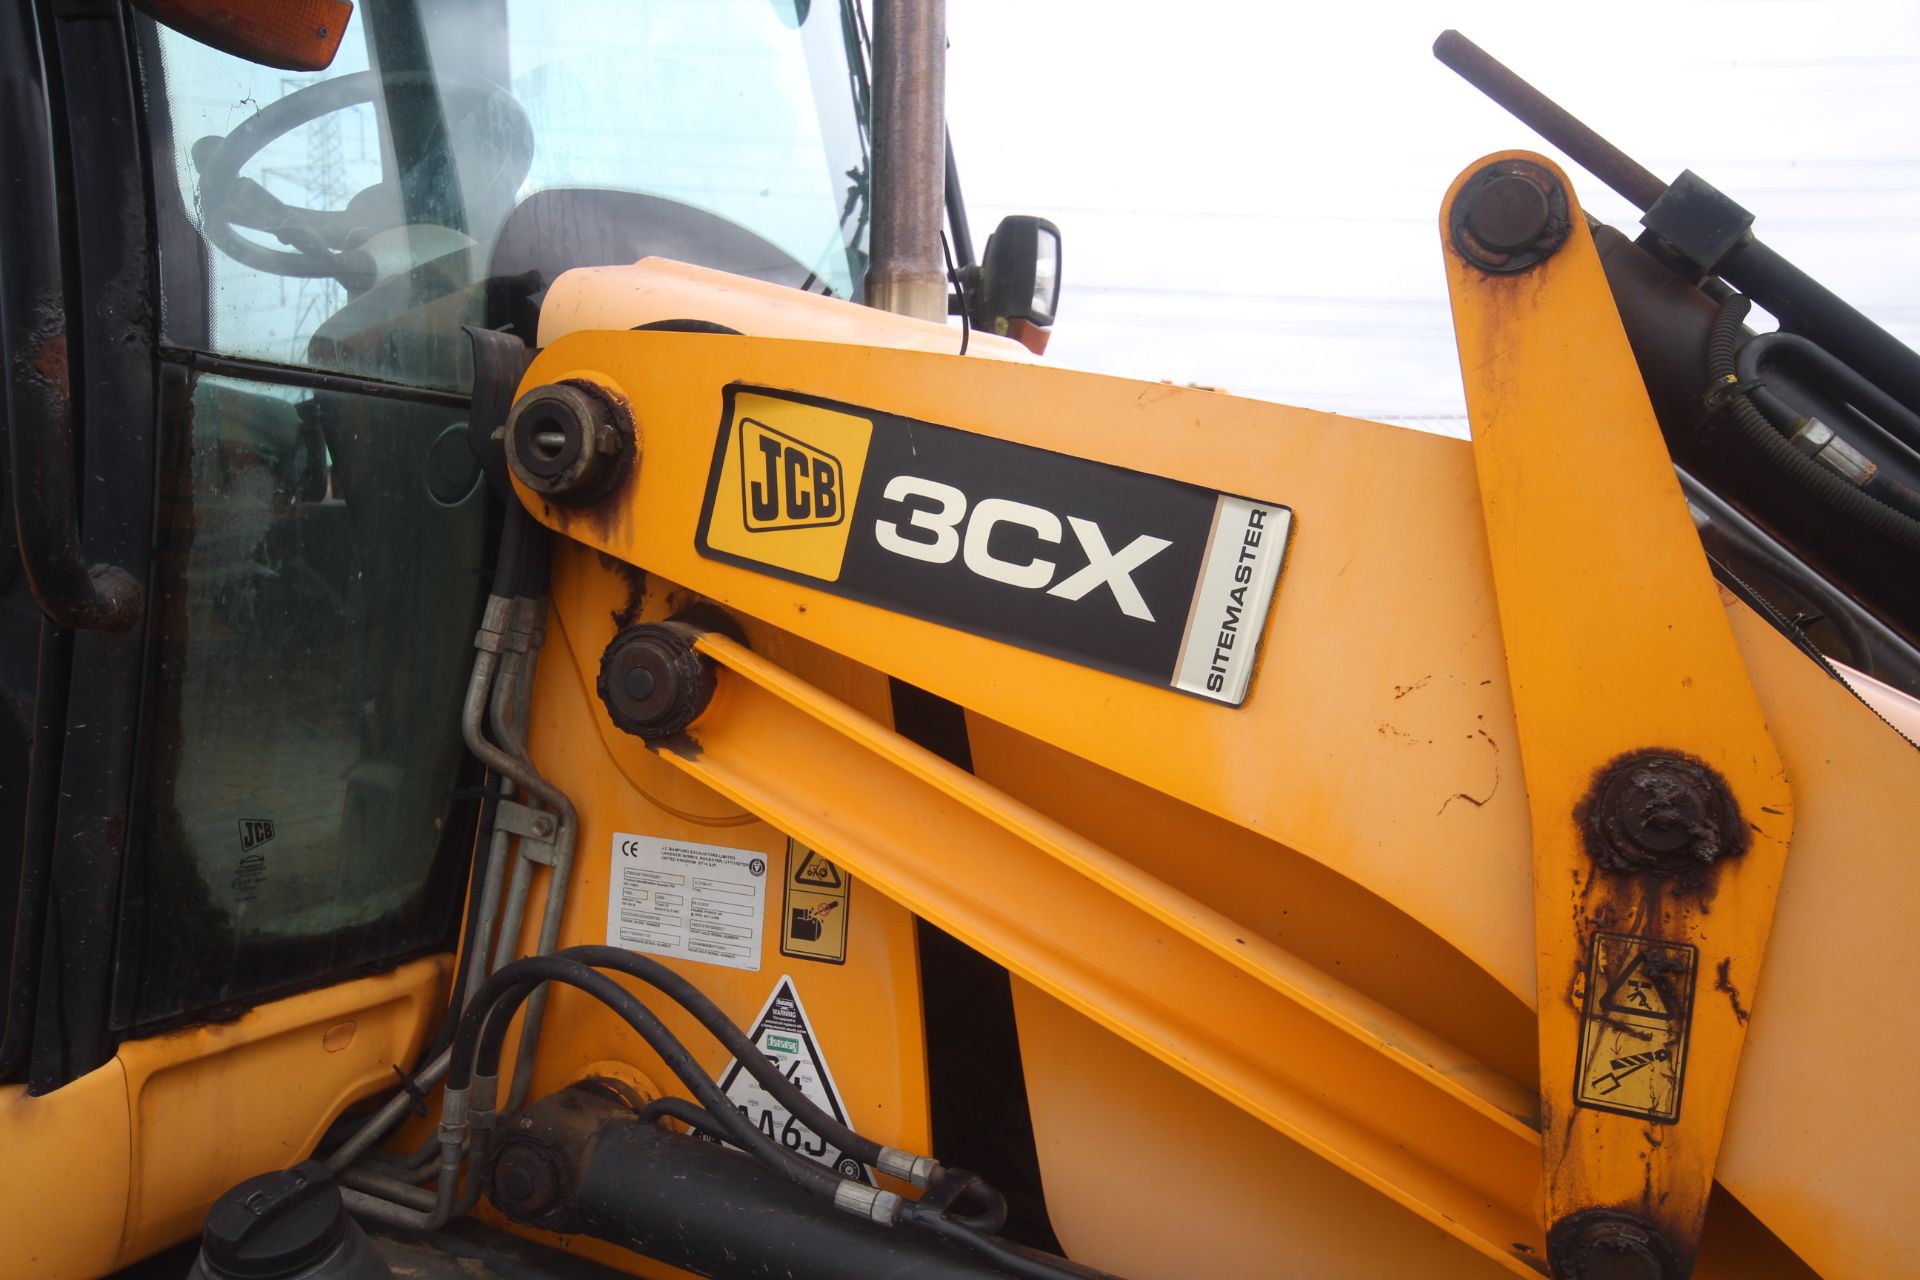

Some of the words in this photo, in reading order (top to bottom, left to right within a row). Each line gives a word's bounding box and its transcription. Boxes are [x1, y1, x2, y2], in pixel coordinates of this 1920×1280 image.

[750, 434, 837, 522] JCB
[874, 475, 1174, 623] 3CX
[1205, 509, 1268, 694] SITEMASTER
[244, 822, 273, 848] JCB
